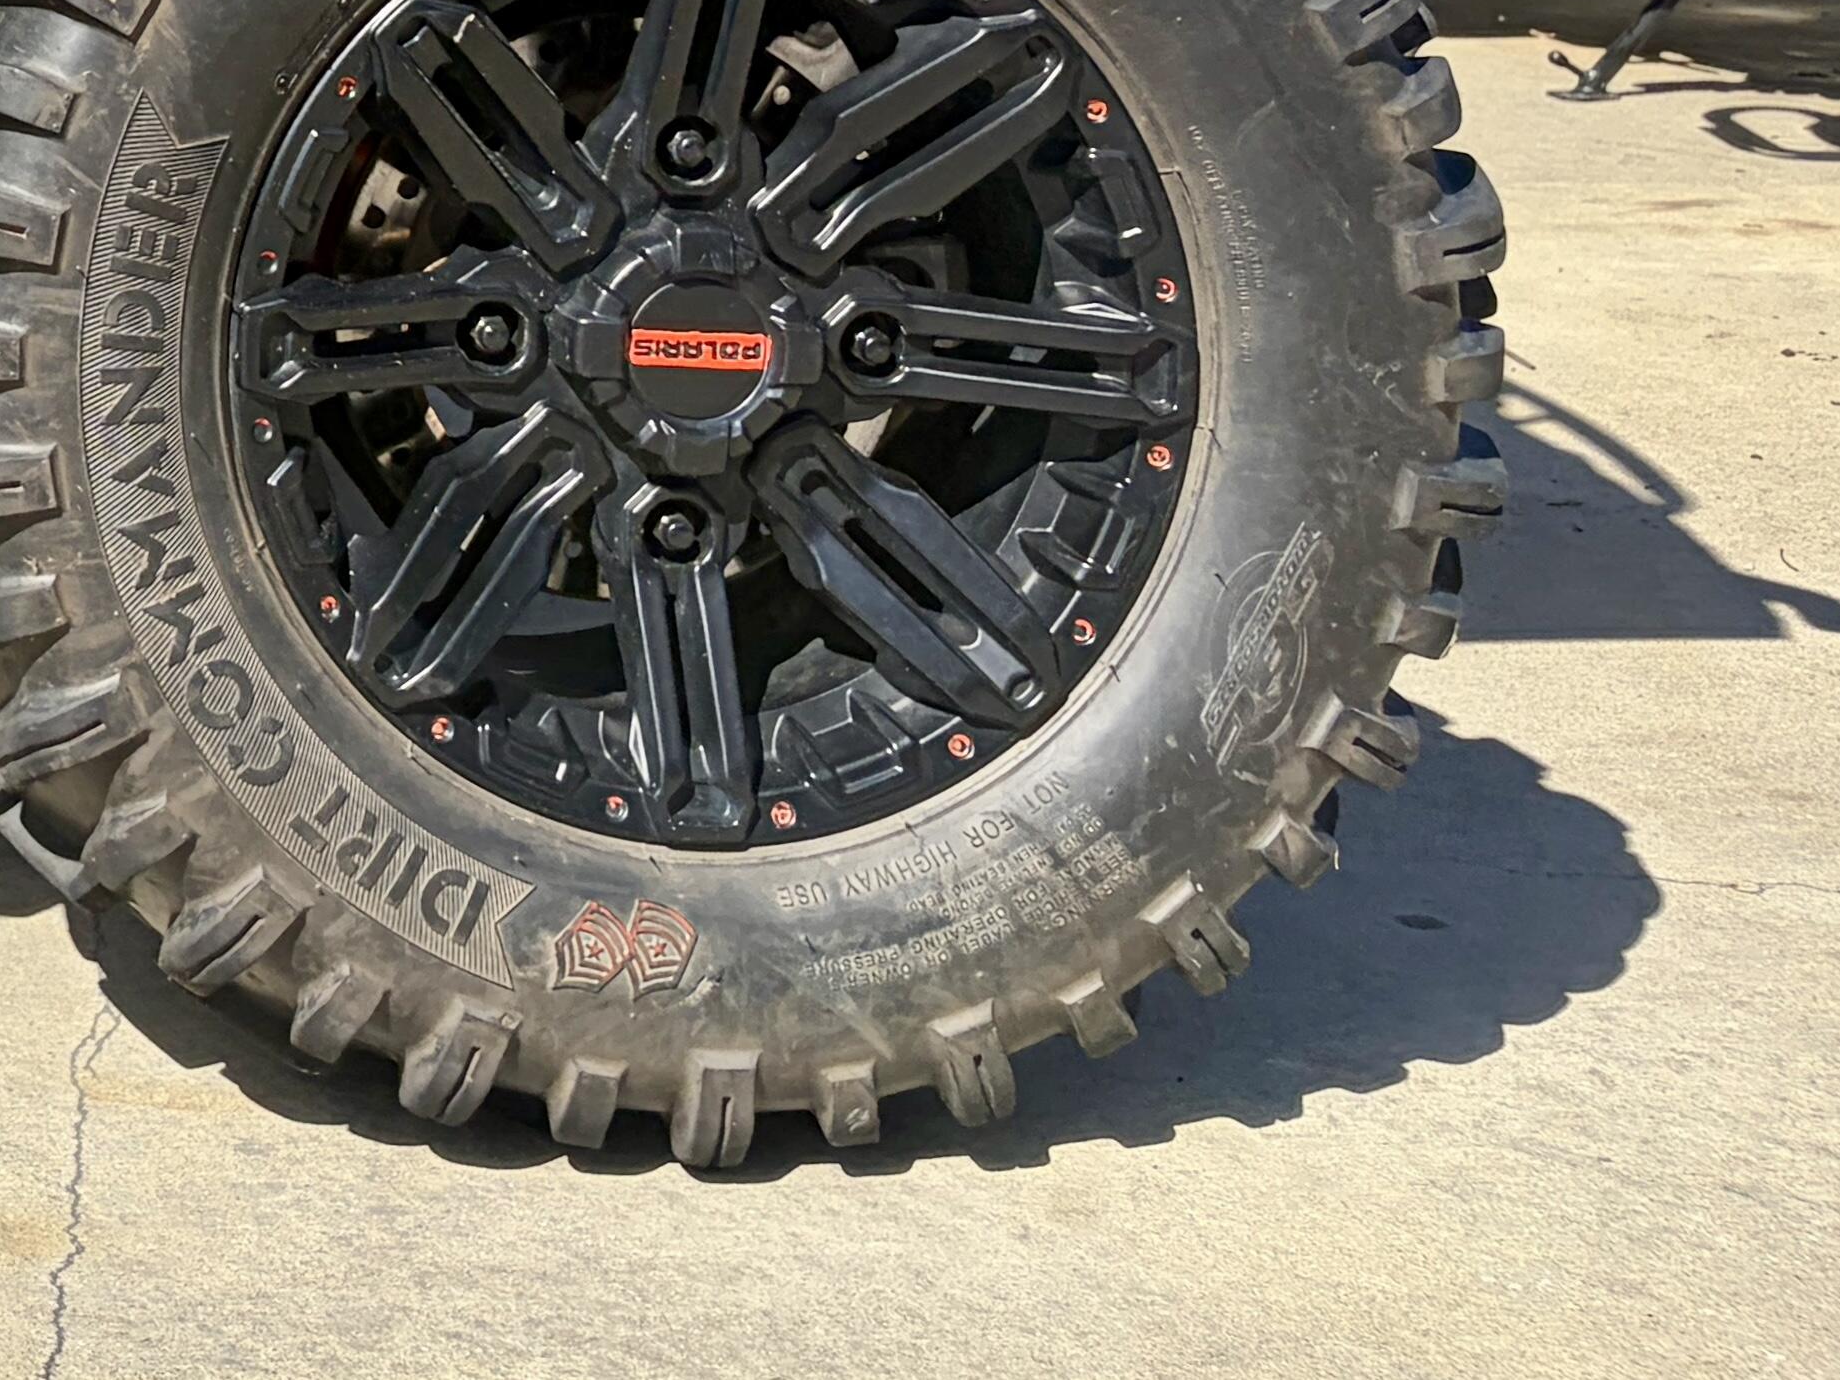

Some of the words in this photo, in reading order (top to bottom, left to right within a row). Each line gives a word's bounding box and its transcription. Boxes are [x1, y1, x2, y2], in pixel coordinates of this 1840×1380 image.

[633, 338, 762, 360] POLARIS
[98, 160, 295, 788] COMMANDER
[1019, 769, 1070, 815] NOT
[962, 807, 1015, 851] FOR
[289, 781, 492, 947] DIRT
[841, 836, 958, 899] HIGHWAY
[775, 879, 827, 910] USE
[1011, 880, 1049, 911] FOR
[908, 902, 1009, 957] OPERATING
